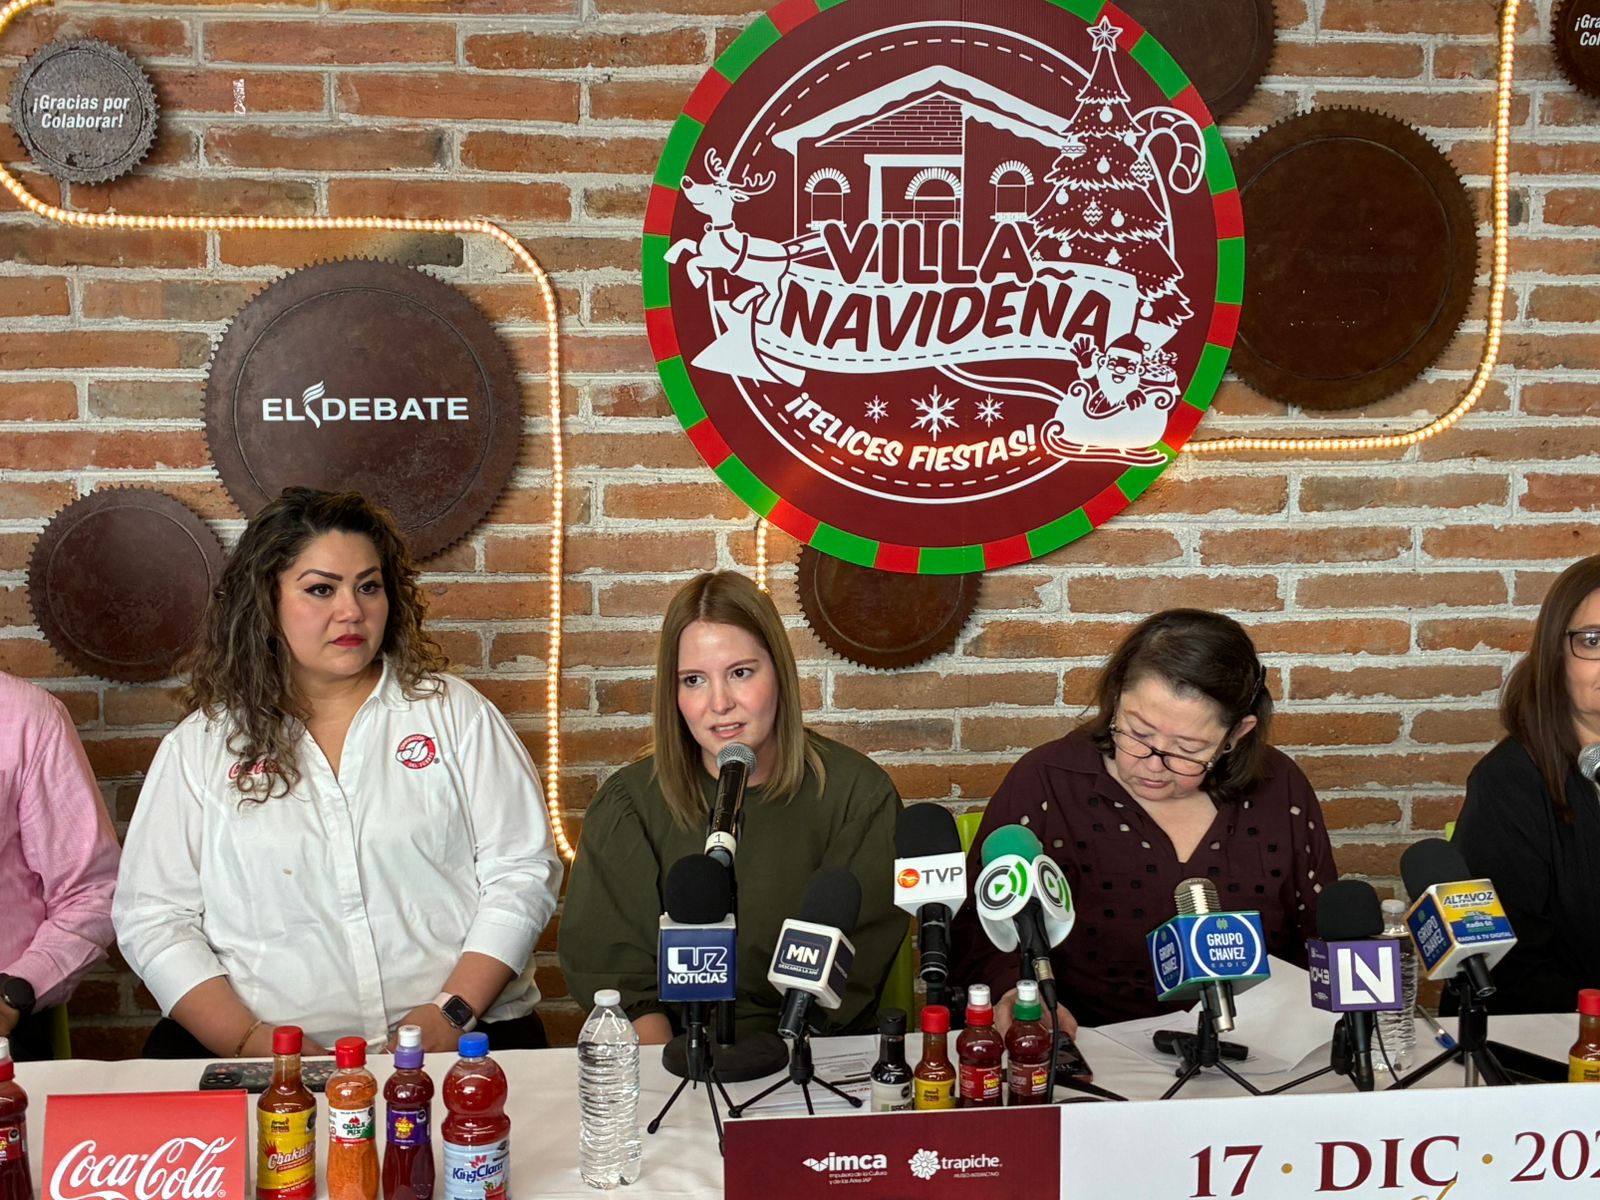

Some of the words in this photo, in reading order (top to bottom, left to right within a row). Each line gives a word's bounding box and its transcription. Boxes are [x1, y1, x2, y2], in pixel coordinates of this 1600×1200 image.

[32, 94, 98, 113] ¡Gracias
[103, 97, 130, 113] por
[41, 113, 124, 129] Colaborar!
[823, 219, 1037, 284] VILLA
[780, 267, 1111, 354] NAVIDEÑA
[262, 397, 305, 421] EL
[321, 397, 470, 421] DEBATE
[784, 392, 904, 468] ¡FELICES
[907, 424, 1037, 473] FIESTAS!
[921, 866, 963, 884] TVP
[1443, 891, 1494, 905] ALTAVOZ
[1206, 932, 1244, 946] GRUPO
[667, 946, 728, 973] LUZ
[786, 943, 820, 965] MN
[1209, 947, 1246, 961] CHAVEZ
[667, 972, 728, 985] NOTICIAS
[50, 1136, 237, 1200] Coca-Cola
[829, 1152, 887, 1171] imca
[941, 1153, 1000, 1172] trapiche
[1190, 1144, 1263, 1198] 17
[1315, 1135, 1460, 1192] DIC
[1510, 1129, 1600, 1182] 20
